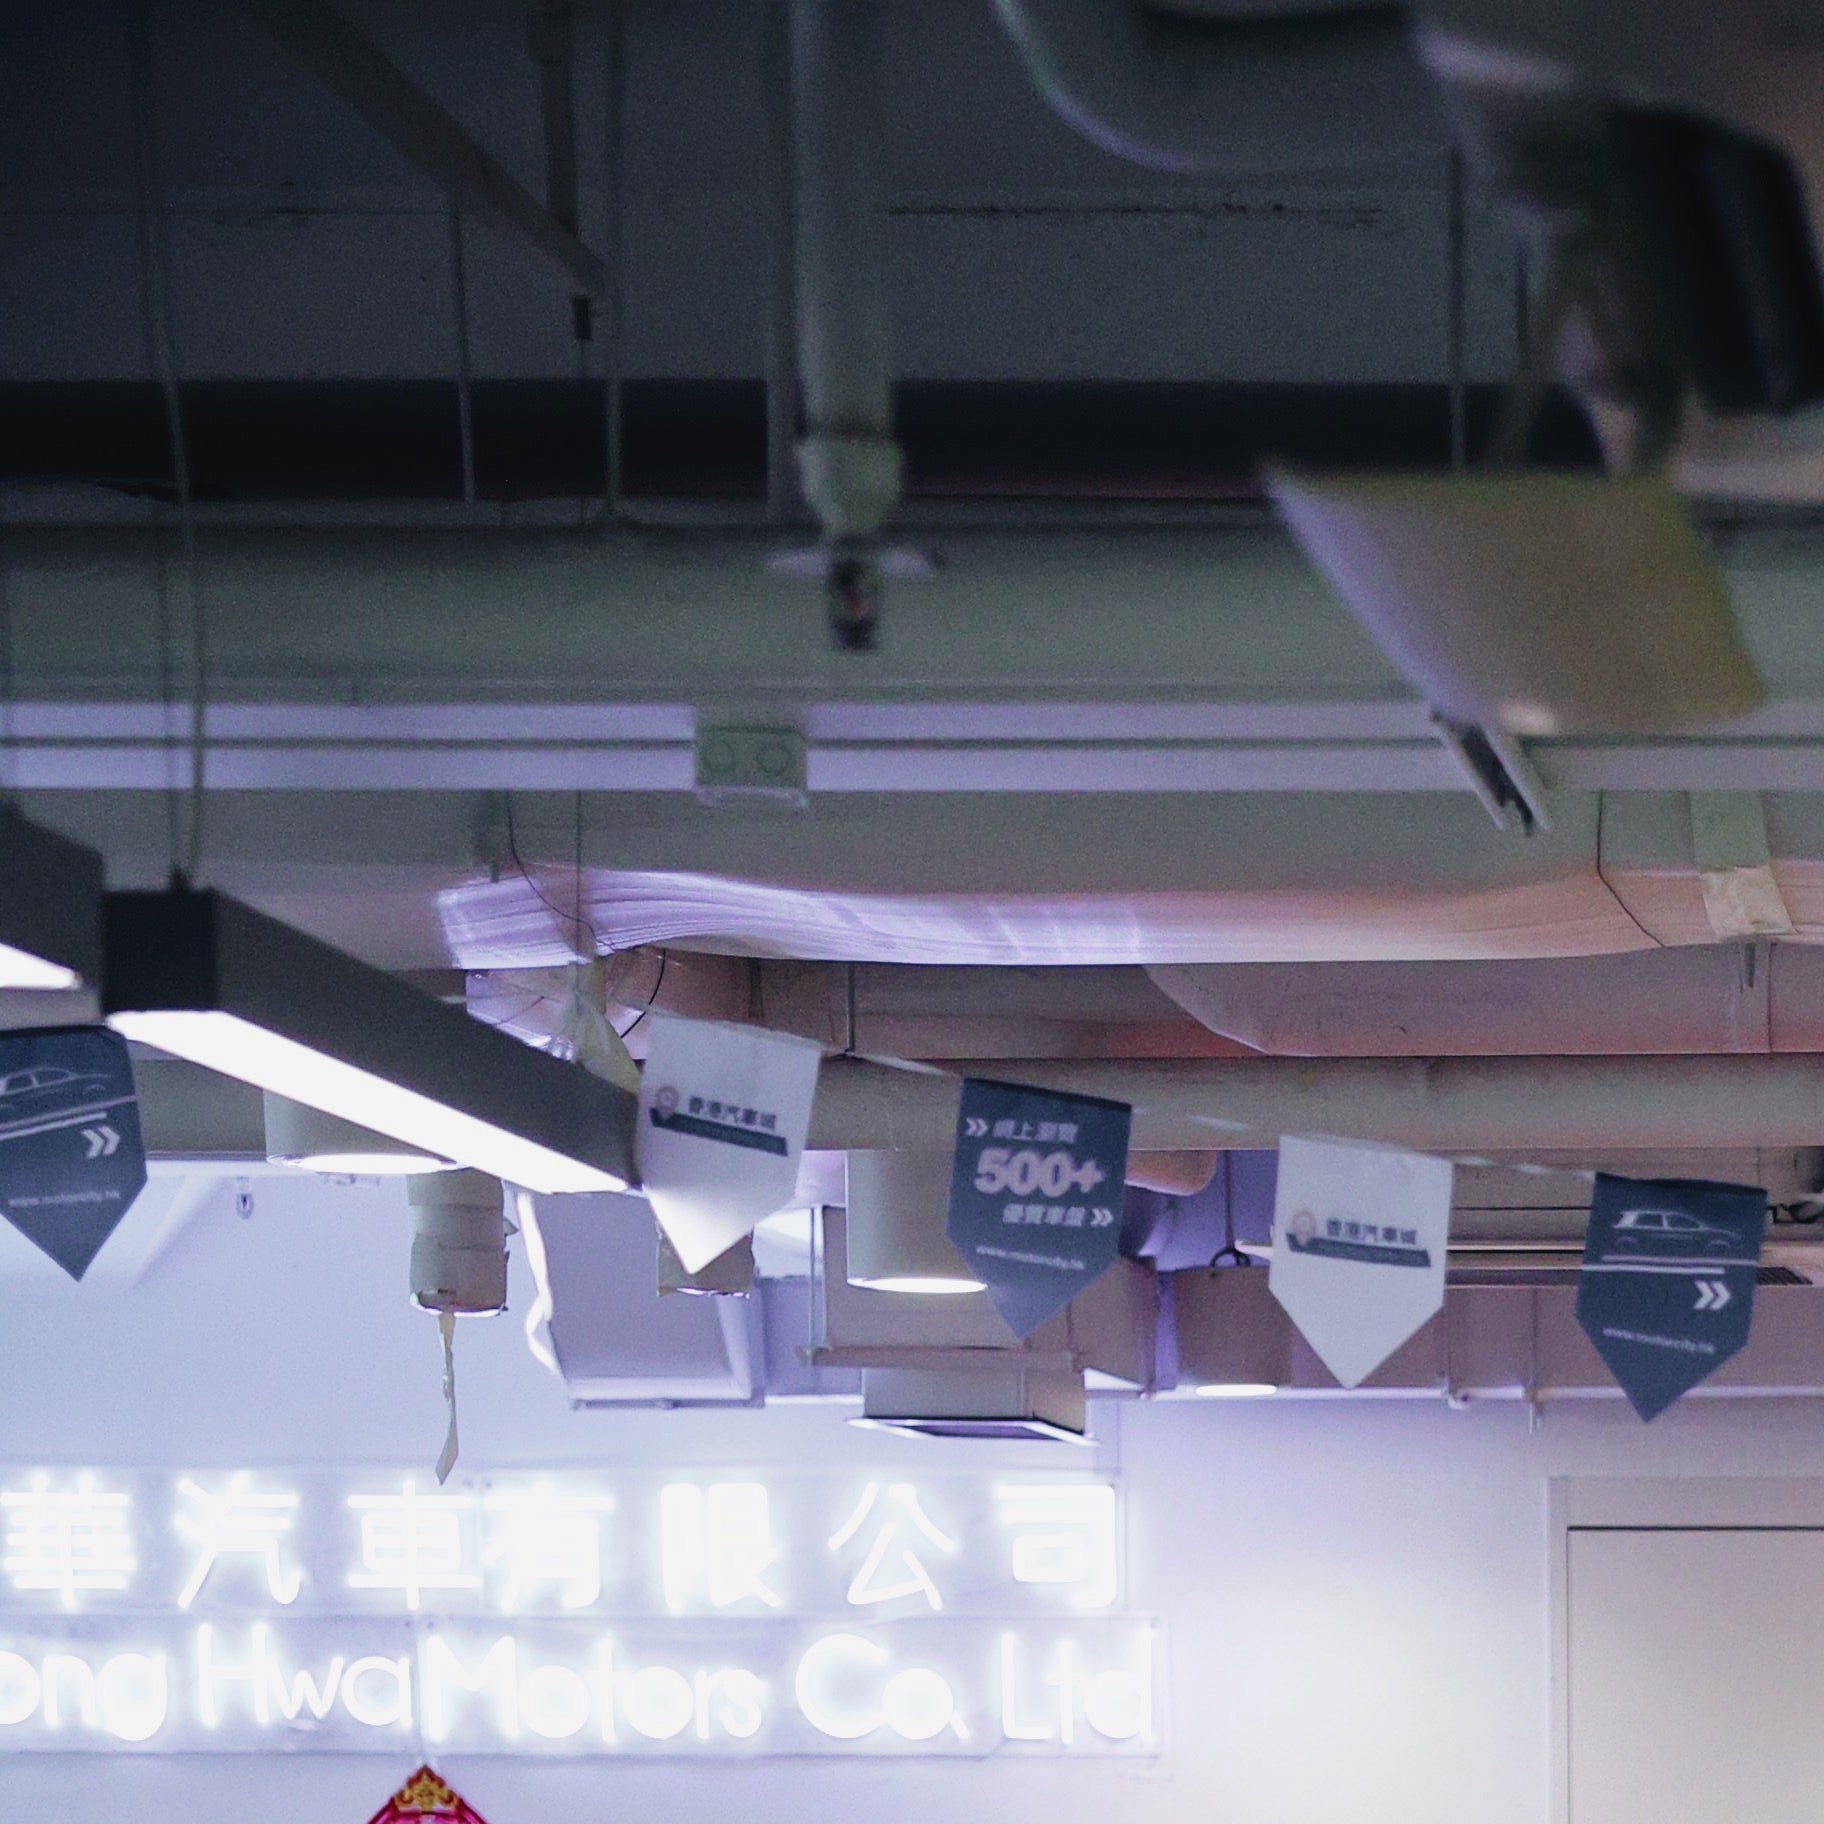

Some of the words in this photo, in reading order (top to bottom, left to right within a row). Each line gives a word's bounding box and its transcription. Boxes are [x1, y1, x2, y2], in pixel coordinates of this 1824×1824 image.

[974, 1148, 1107, 1197] 500+
[196, 1621, 413, 1727] Hwa
[423, 1634, 766, 1744] Motors
[1001, 1626, 1155, 1745] Ltd
